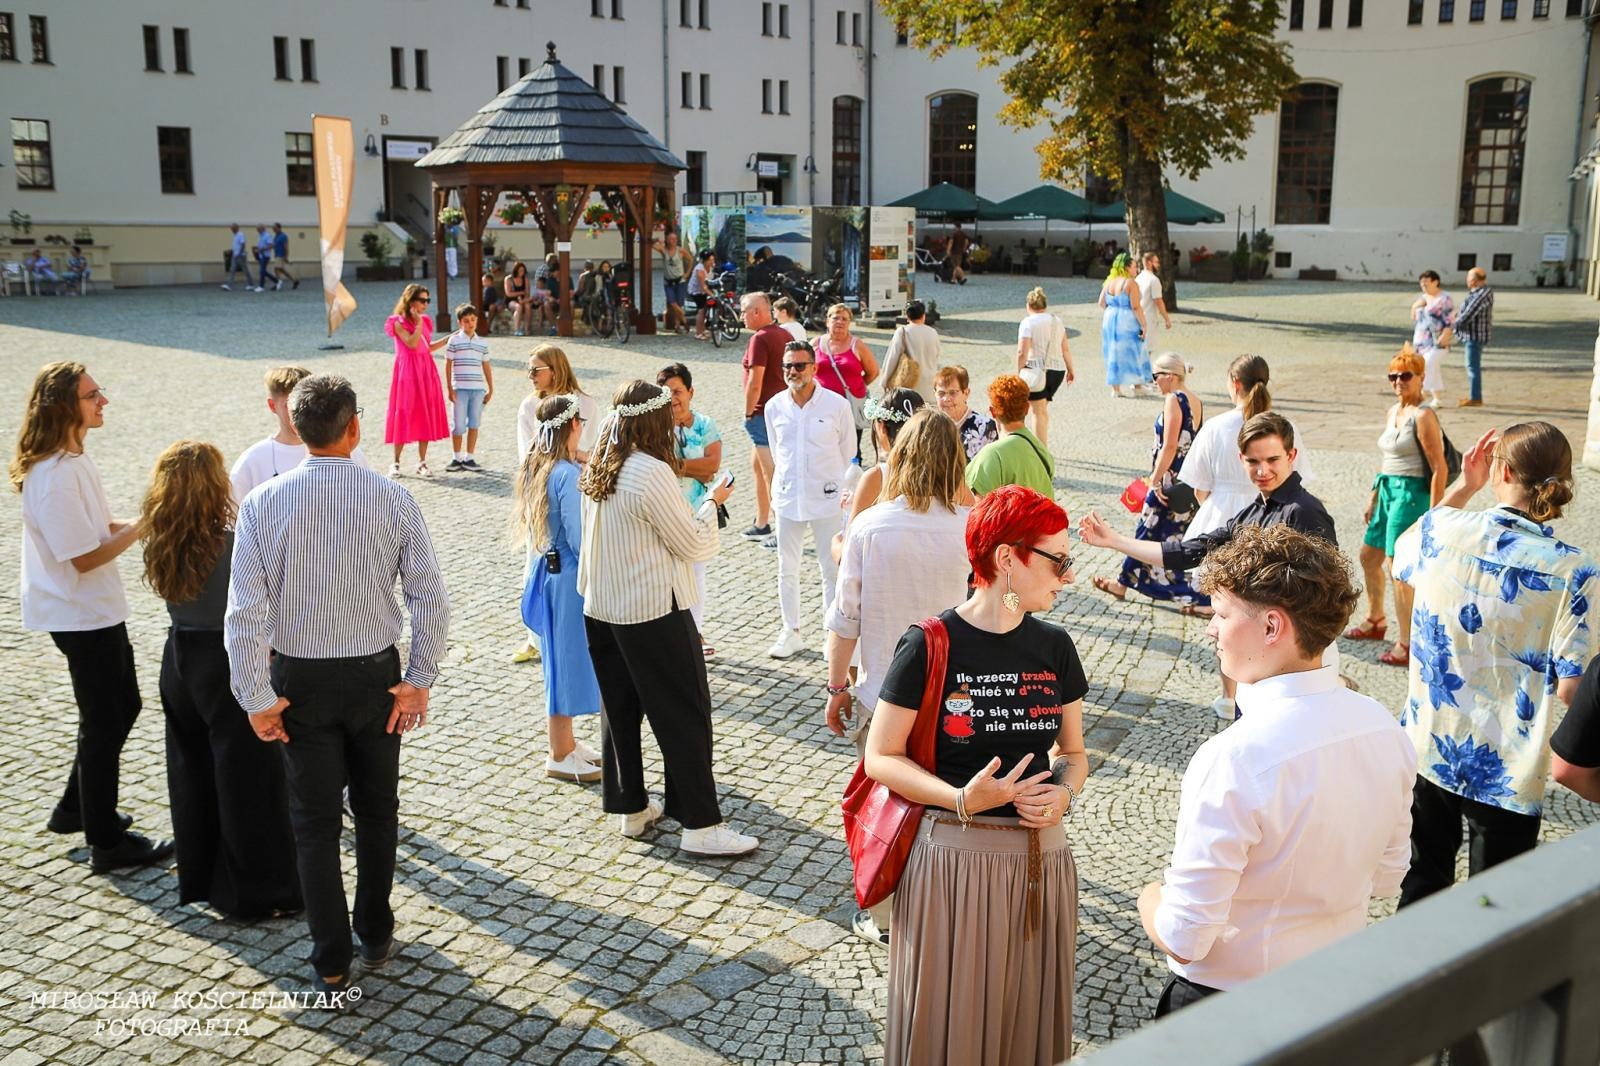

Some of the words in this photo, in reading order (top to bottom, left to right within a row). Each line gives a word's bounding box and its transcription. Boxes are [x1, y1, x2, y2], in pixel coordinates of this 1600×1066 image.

[977, 673, 1018, 684] rzeczy
[1022, 671, 1056, 681] trzeba
[969, 686, 1001, 697] mieć
[1005, 688, 1015, 696] w
[969, 707, 985, 718] to
[989, 706, 1010, 719] się
[1012, 707, 1025, 716] w
[985, 720, 1007, 732] nie
[1012, 719, 1058, 730] mieści.
